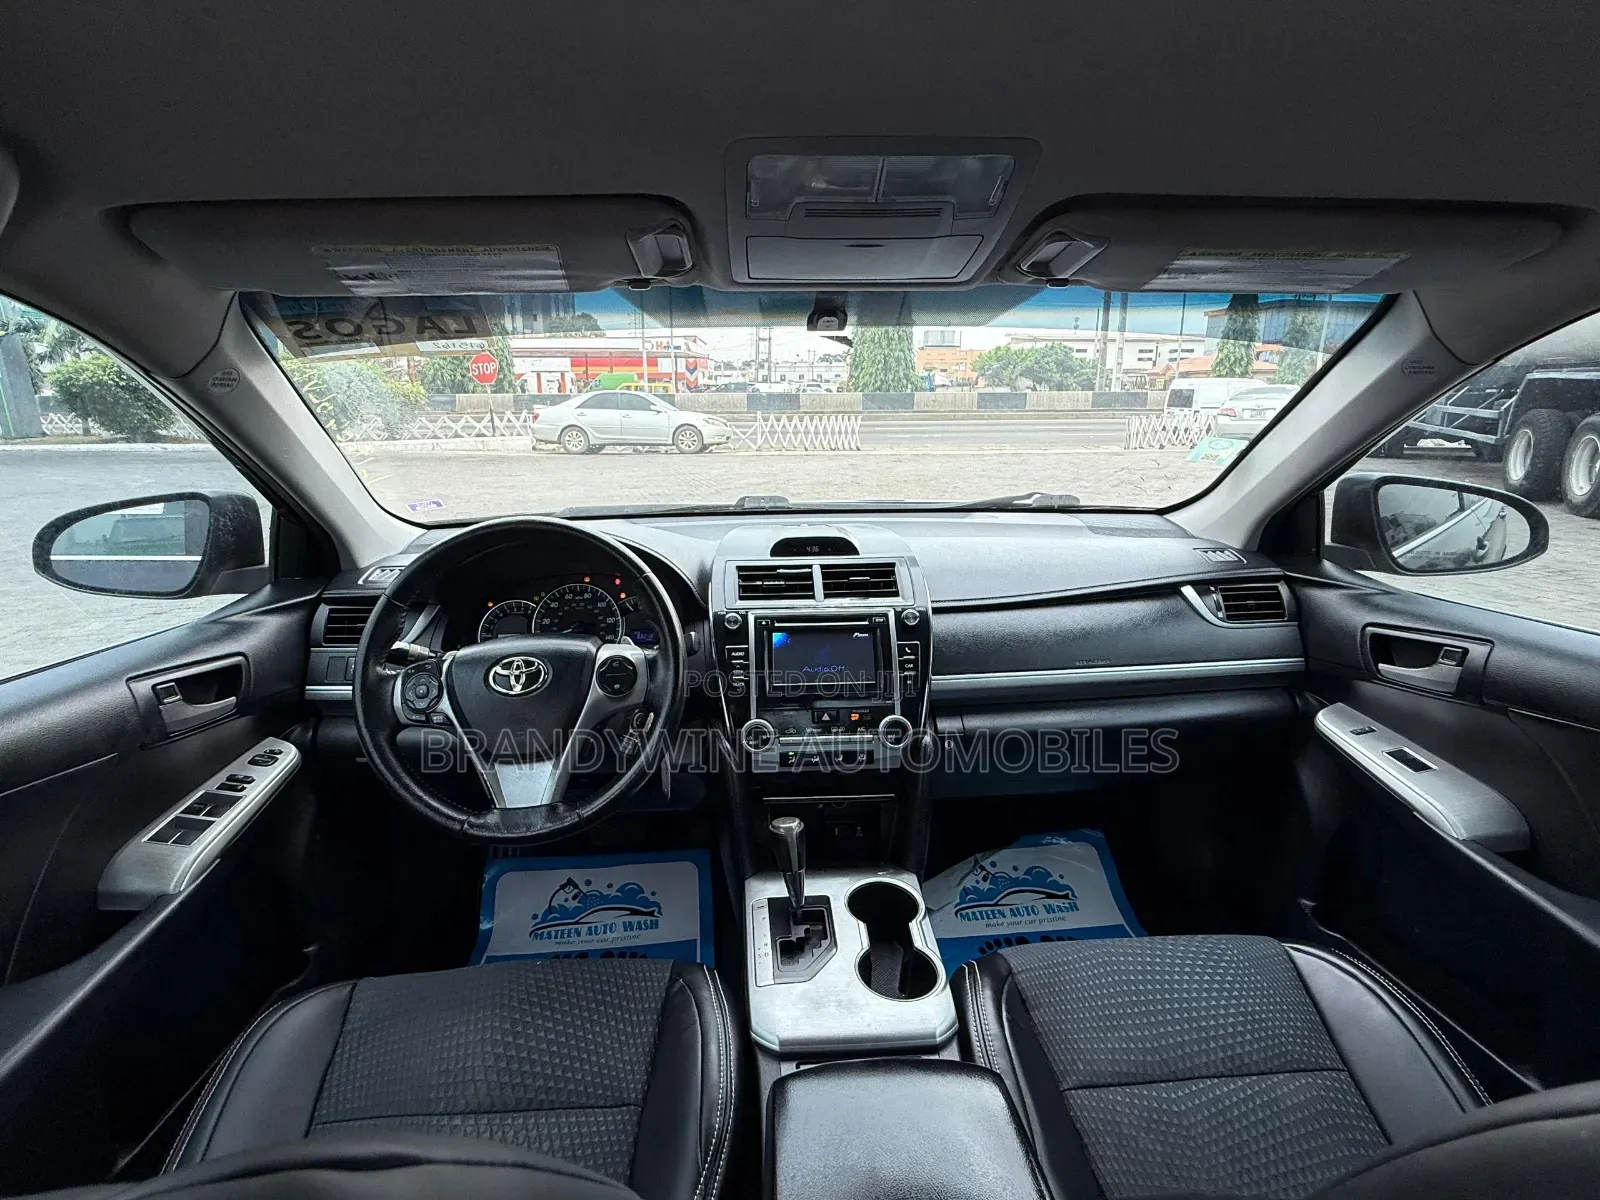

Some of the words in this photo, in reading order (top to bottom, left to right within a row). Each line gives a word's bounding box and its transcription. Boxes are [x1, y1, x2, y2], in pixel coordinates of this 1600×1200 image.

[471, 361, 497, 375] STOP
[802, 665, 829, 673] Audio
[958, 909, 1006, 923] MATEEN
[1009, 904, 1040, 918] AUTO
[1042, 900, 1080, 913] WASH
[985, 920, 1005, 929] make
[1006, 920, 1024, 929] your
[1024, 918, 1038, 926] car
[1038, 915, 1067, 925] pristine
[531, 926, 582, 941] MATEEN
[585, 922, 617, 937] AUTO
[622, 919, 660, 932] WASH
[554, 938, 575, 946] make
[611, 933, 641, 943] pristine
